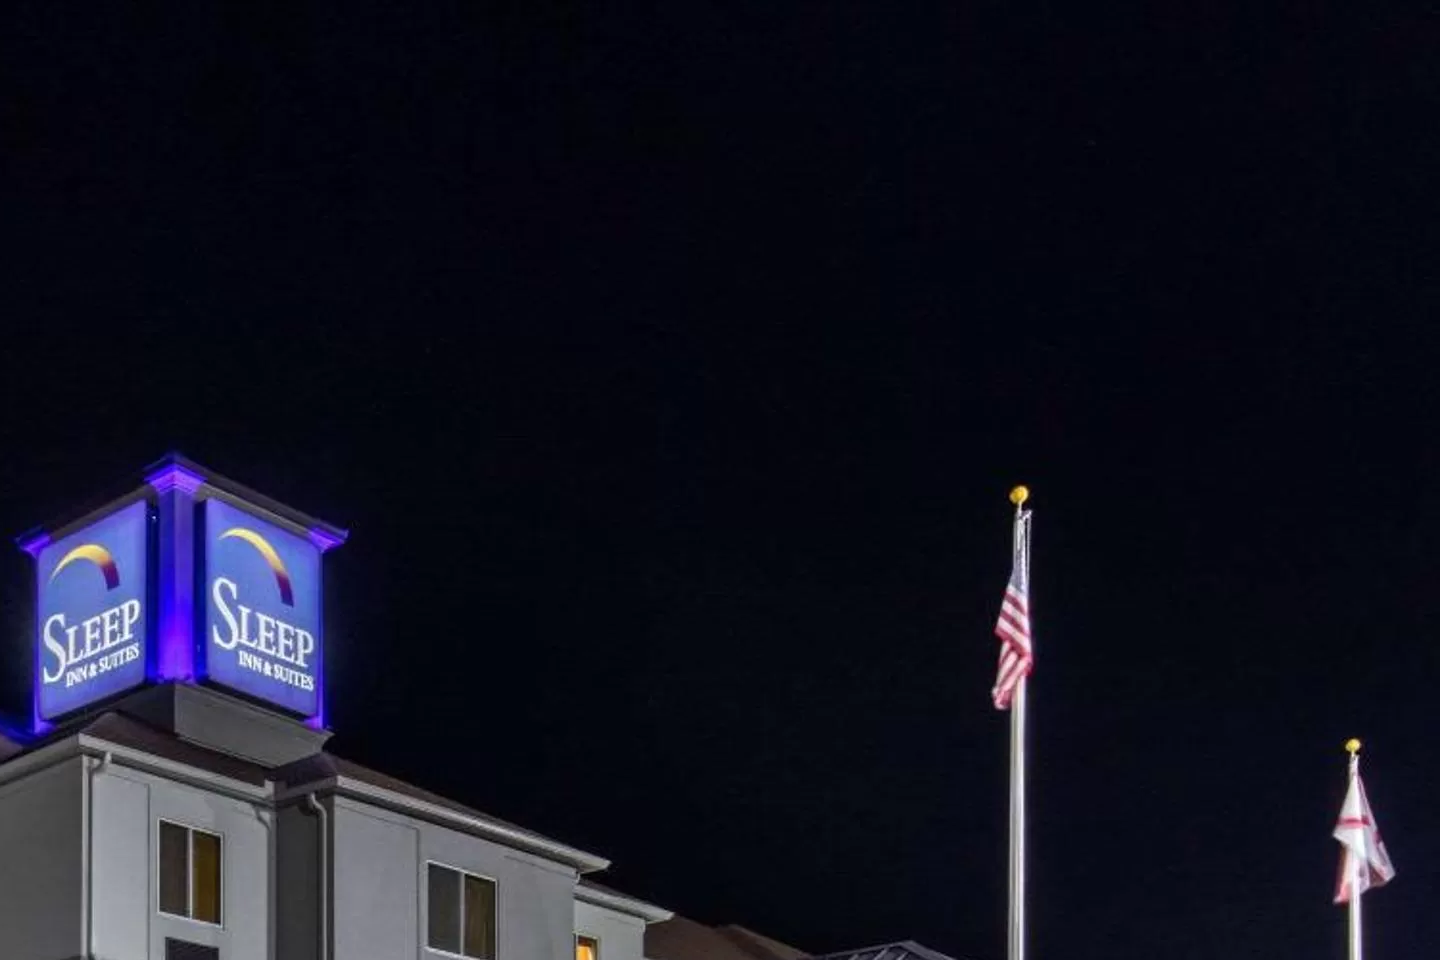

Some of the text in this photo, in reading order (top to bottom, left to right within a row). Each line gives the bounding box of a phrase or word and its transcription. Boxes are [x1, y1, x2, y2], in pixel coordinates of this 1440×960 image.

[65, 642, 140, 688] INN & SUITES
[239, 650, 314, 692] INN & SUITES
